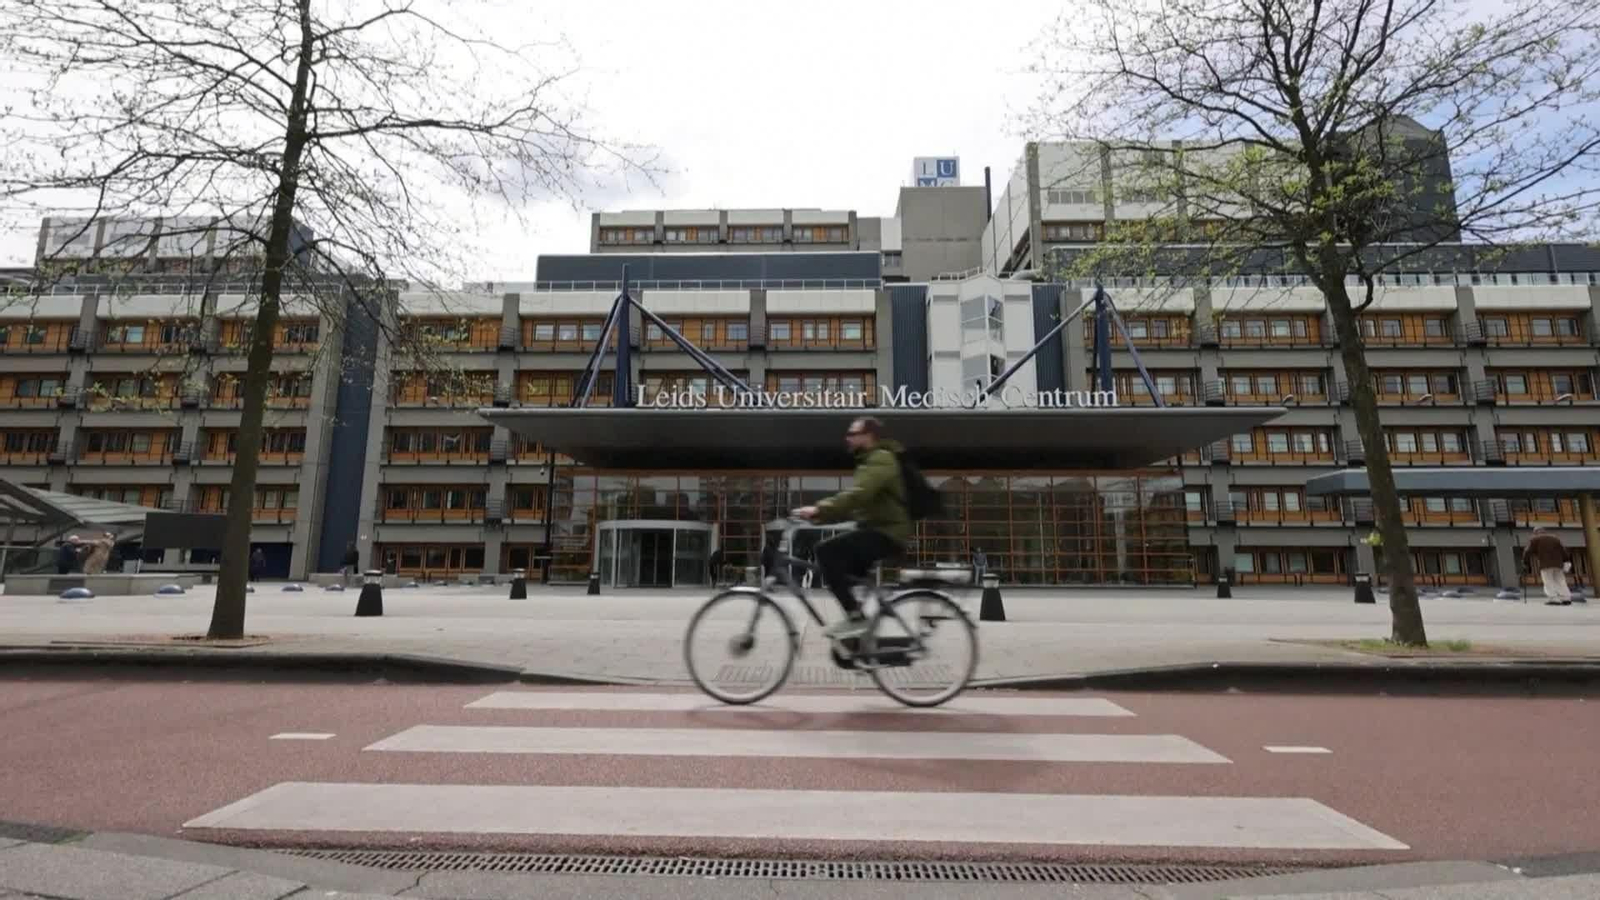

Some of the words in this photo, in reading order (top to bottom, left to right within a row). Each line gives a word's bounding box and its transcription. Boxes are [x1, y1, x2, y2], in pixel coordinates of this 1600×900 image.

[636, 383, 707, 408] Leids
[716, 384, 867, 408] Universitair
[879, 383, 989, 409] Medisch
[1001, 384, 1119, 408] Centrum
